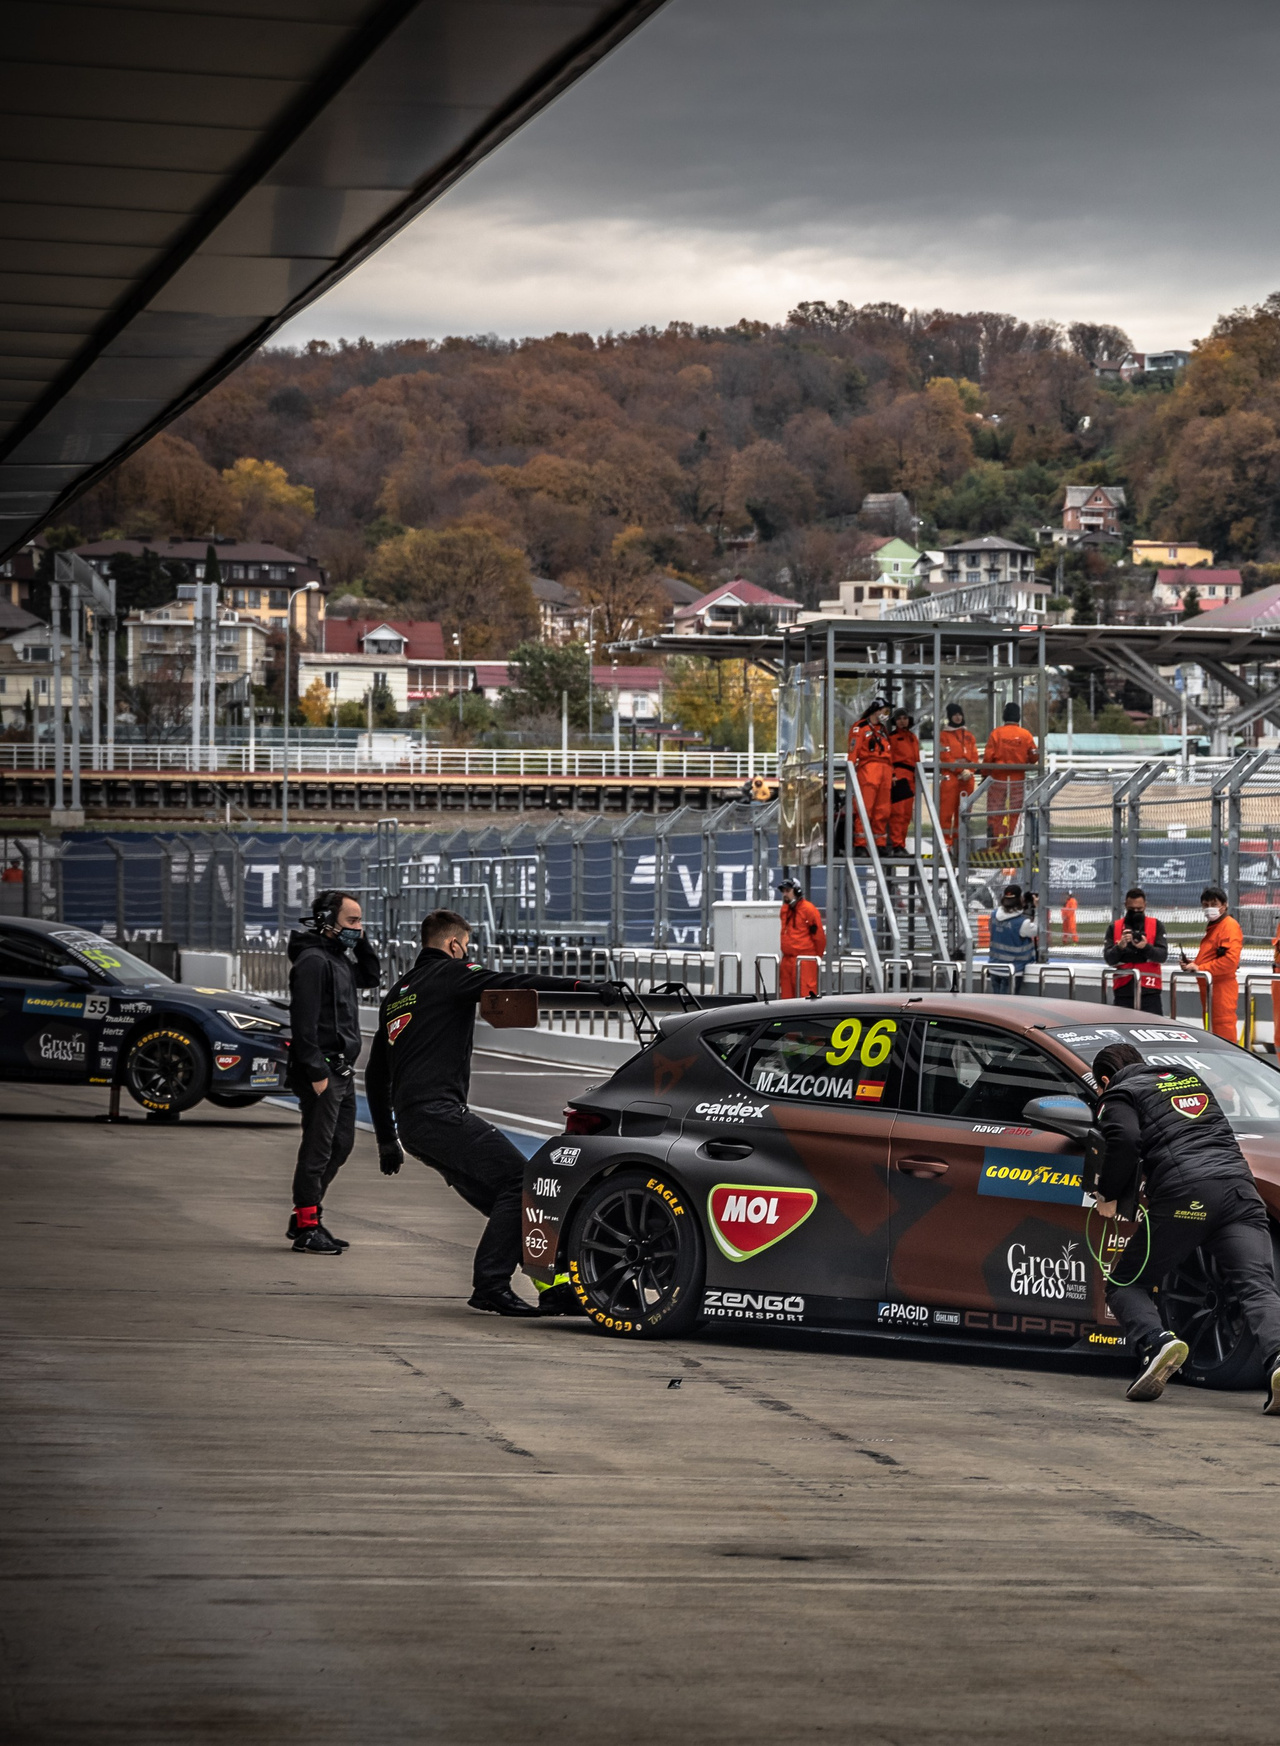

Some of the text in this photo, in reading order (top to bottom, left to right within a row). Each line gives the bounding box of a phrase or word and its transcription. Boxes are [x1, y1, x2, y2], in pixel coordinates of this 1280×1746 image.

[81, 949, 121, 969] 55
[1145, 976, 1156, 987] 21
[26, 997, 83, 1009] GOODYEAR
[87, 1000, 108, 1014] 55
[102, 1028, 124, 1036] Hertz
[137, 1030, 191, 1047] GOODYEAR
[39, 1032, 86, 1053] Green
[826, 1018, 897, 1067] 96
[41, 1046, 73, 1061] Grass
[755, 1071, 853, 1099] M.AZCONA
[695, 1101, 770, 1118] cardex
[1178, 1096, 1201, 1109] MOL
[645, 1178, 685, 1217] EAGLE
[721, 1195, 780, 1225] MOL
[1007, 1242, 1086, 1283] Green
[1010, 1268, 1067, 1300] Grass
[1066, 1283, 1087, 1293] NATURE
[569, 1260, 633, 1332] GOODYEAR
[1065, 1291, 1087, 1300] PRODUCT
[703, 1307, 805, 1322] MOTORSPORT
[890, 1303, 929, 1321] PAGID
[935, 1312, 959, 1323] ÖHLINS
